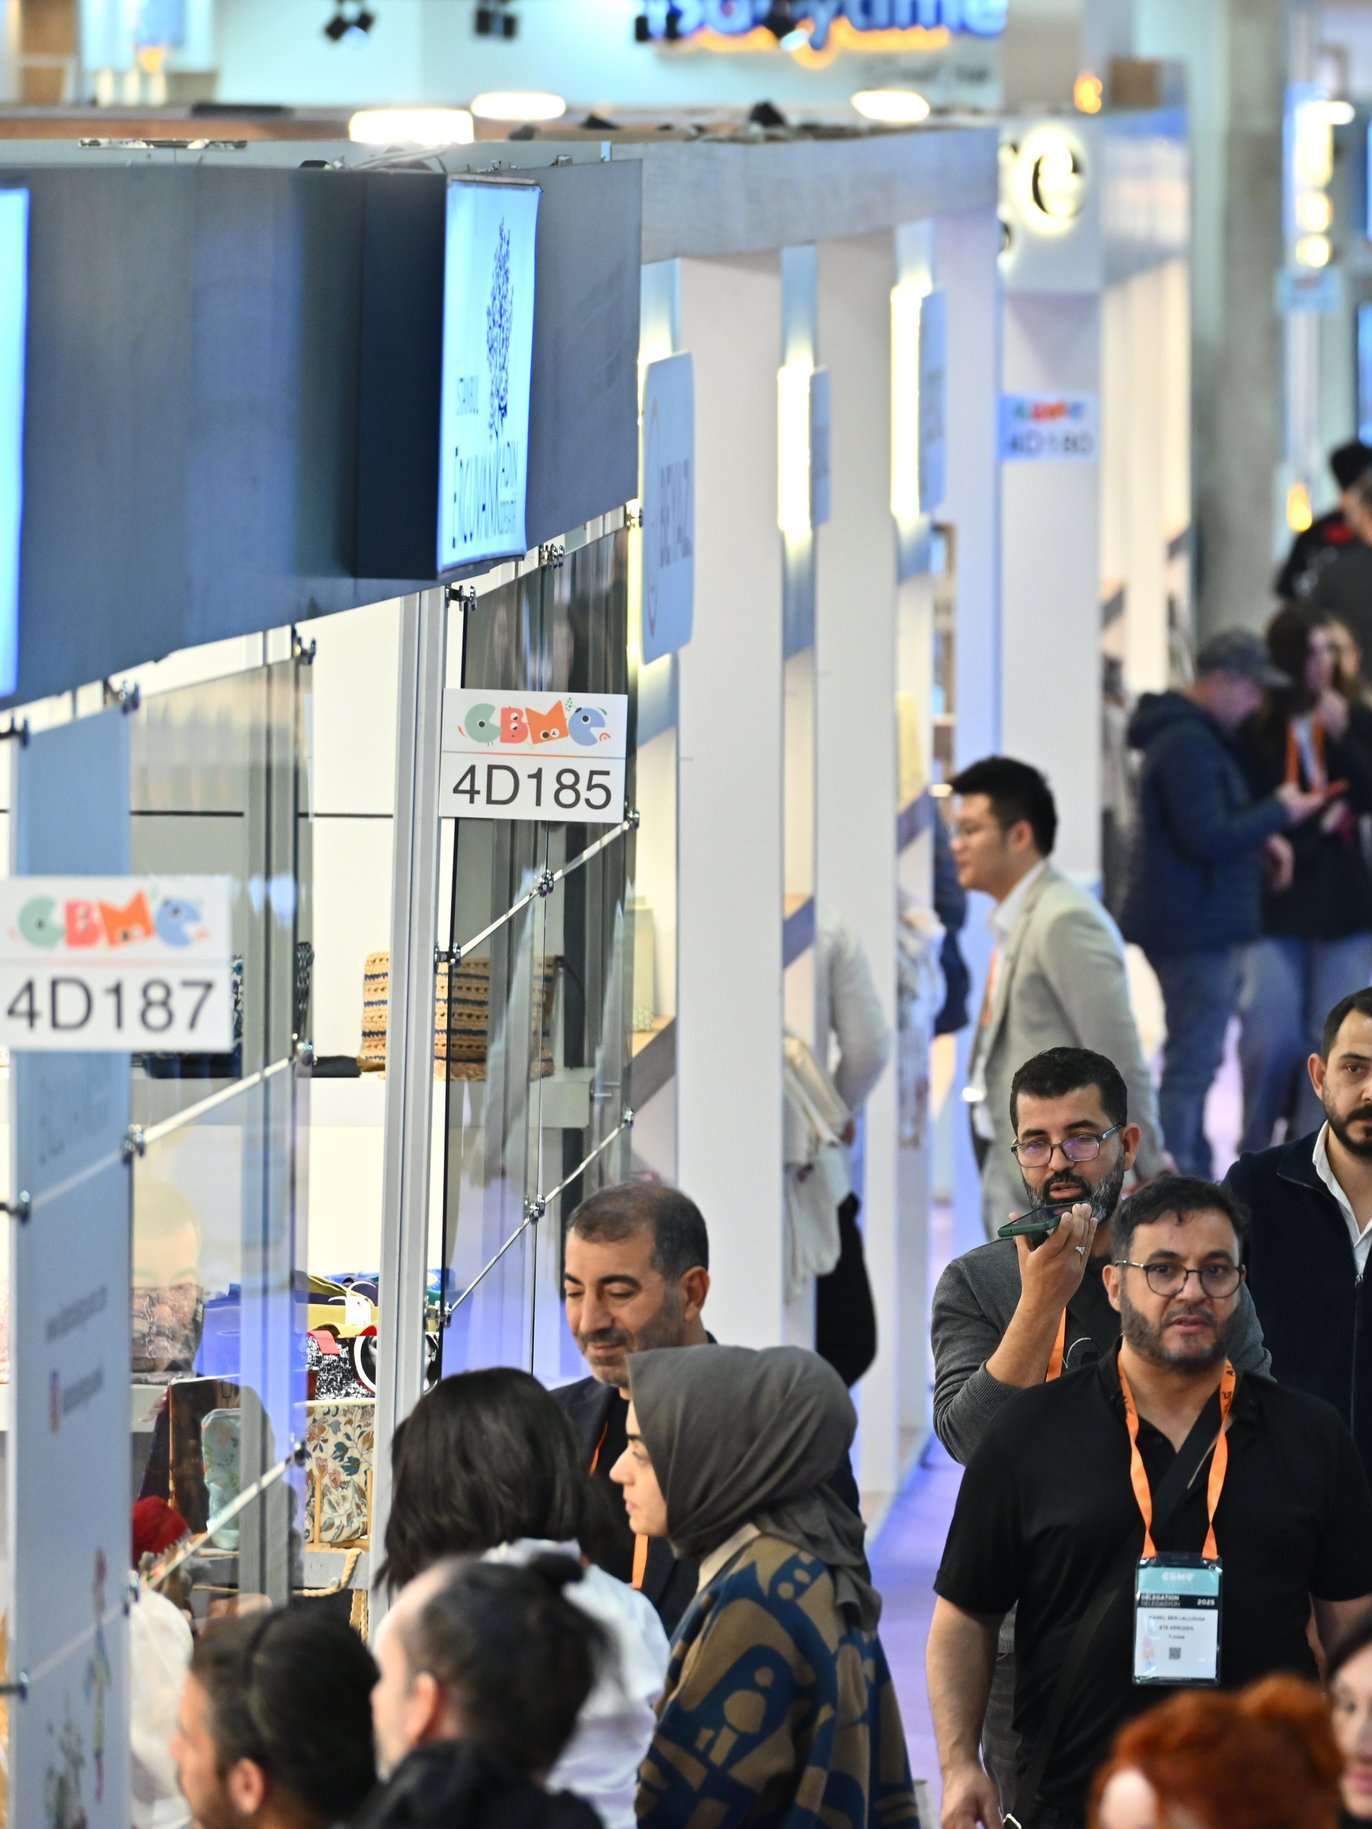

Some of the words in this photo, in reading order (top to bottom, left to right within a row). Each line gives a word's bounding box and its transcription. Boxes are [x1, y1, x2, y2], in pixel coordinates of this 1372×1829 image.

[452, 764, 612, 810] 4D185
[7, 976, 214, 1033] 4D187
[1197, 1599, 1215, 1607] 2025
